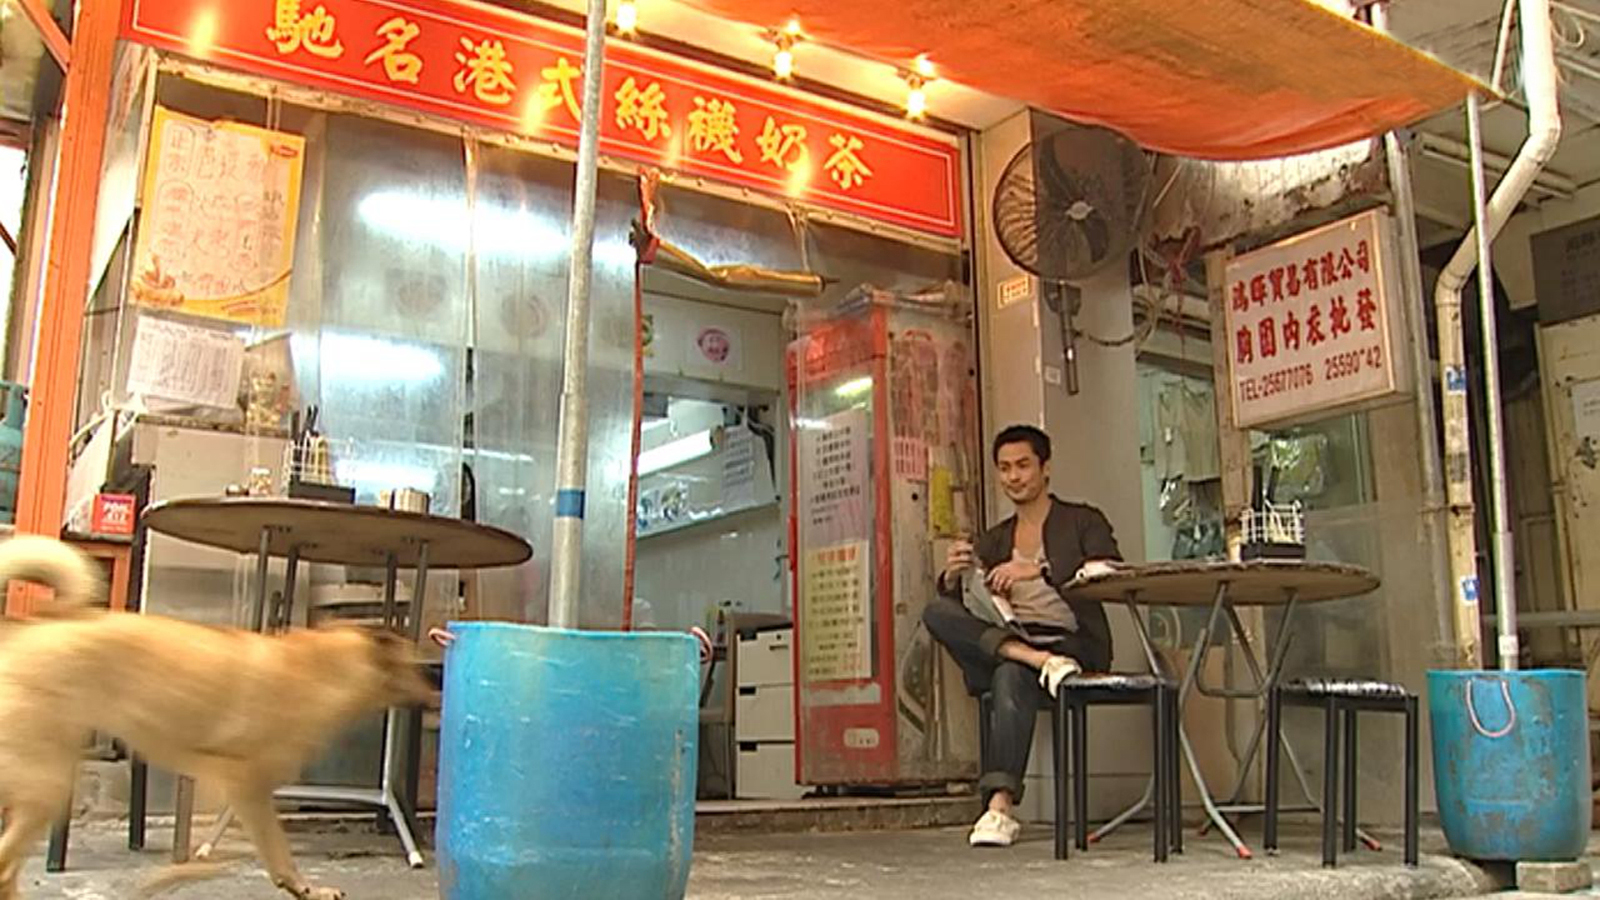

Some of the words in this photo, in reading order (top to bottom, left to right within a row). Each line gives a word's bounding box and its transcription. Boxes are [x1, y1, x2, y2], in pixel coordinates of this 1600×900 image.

[264, 0, 873, 191] 馳名港式絲襪奶茶
[1324, 345, 1382, 382] 2559042
